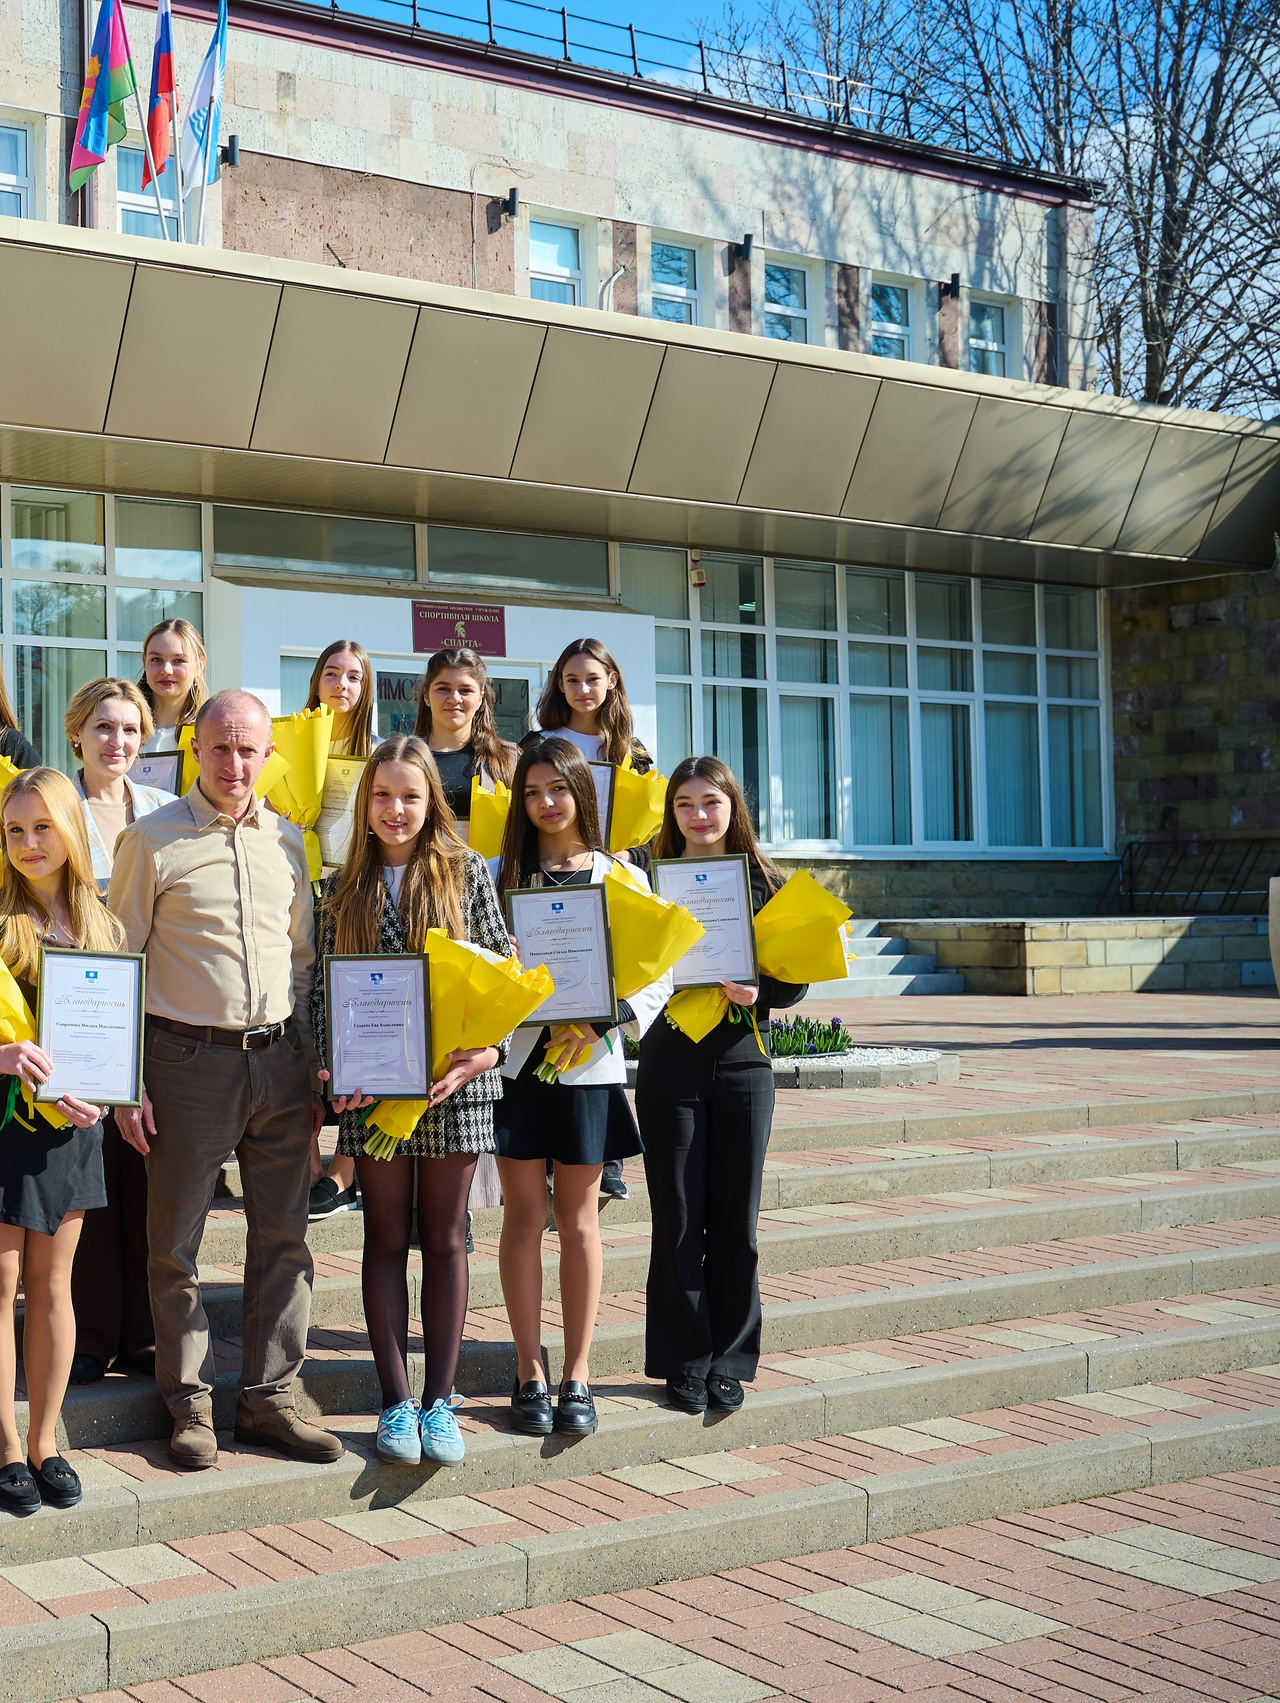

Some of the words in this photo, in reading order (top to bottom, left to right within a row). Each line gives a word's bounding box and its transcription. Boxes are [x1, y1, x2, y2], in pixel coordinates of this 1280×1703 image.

[419, 611, 470, 620] СПОРТИВНАЯ
[472, 614, 499, 622] ШКОЛА
[525, 926, 593, 937] Благодарность
[54, 994, 125, 1009] Благодарность
[342, 997, 412, 1009] Благодарность
